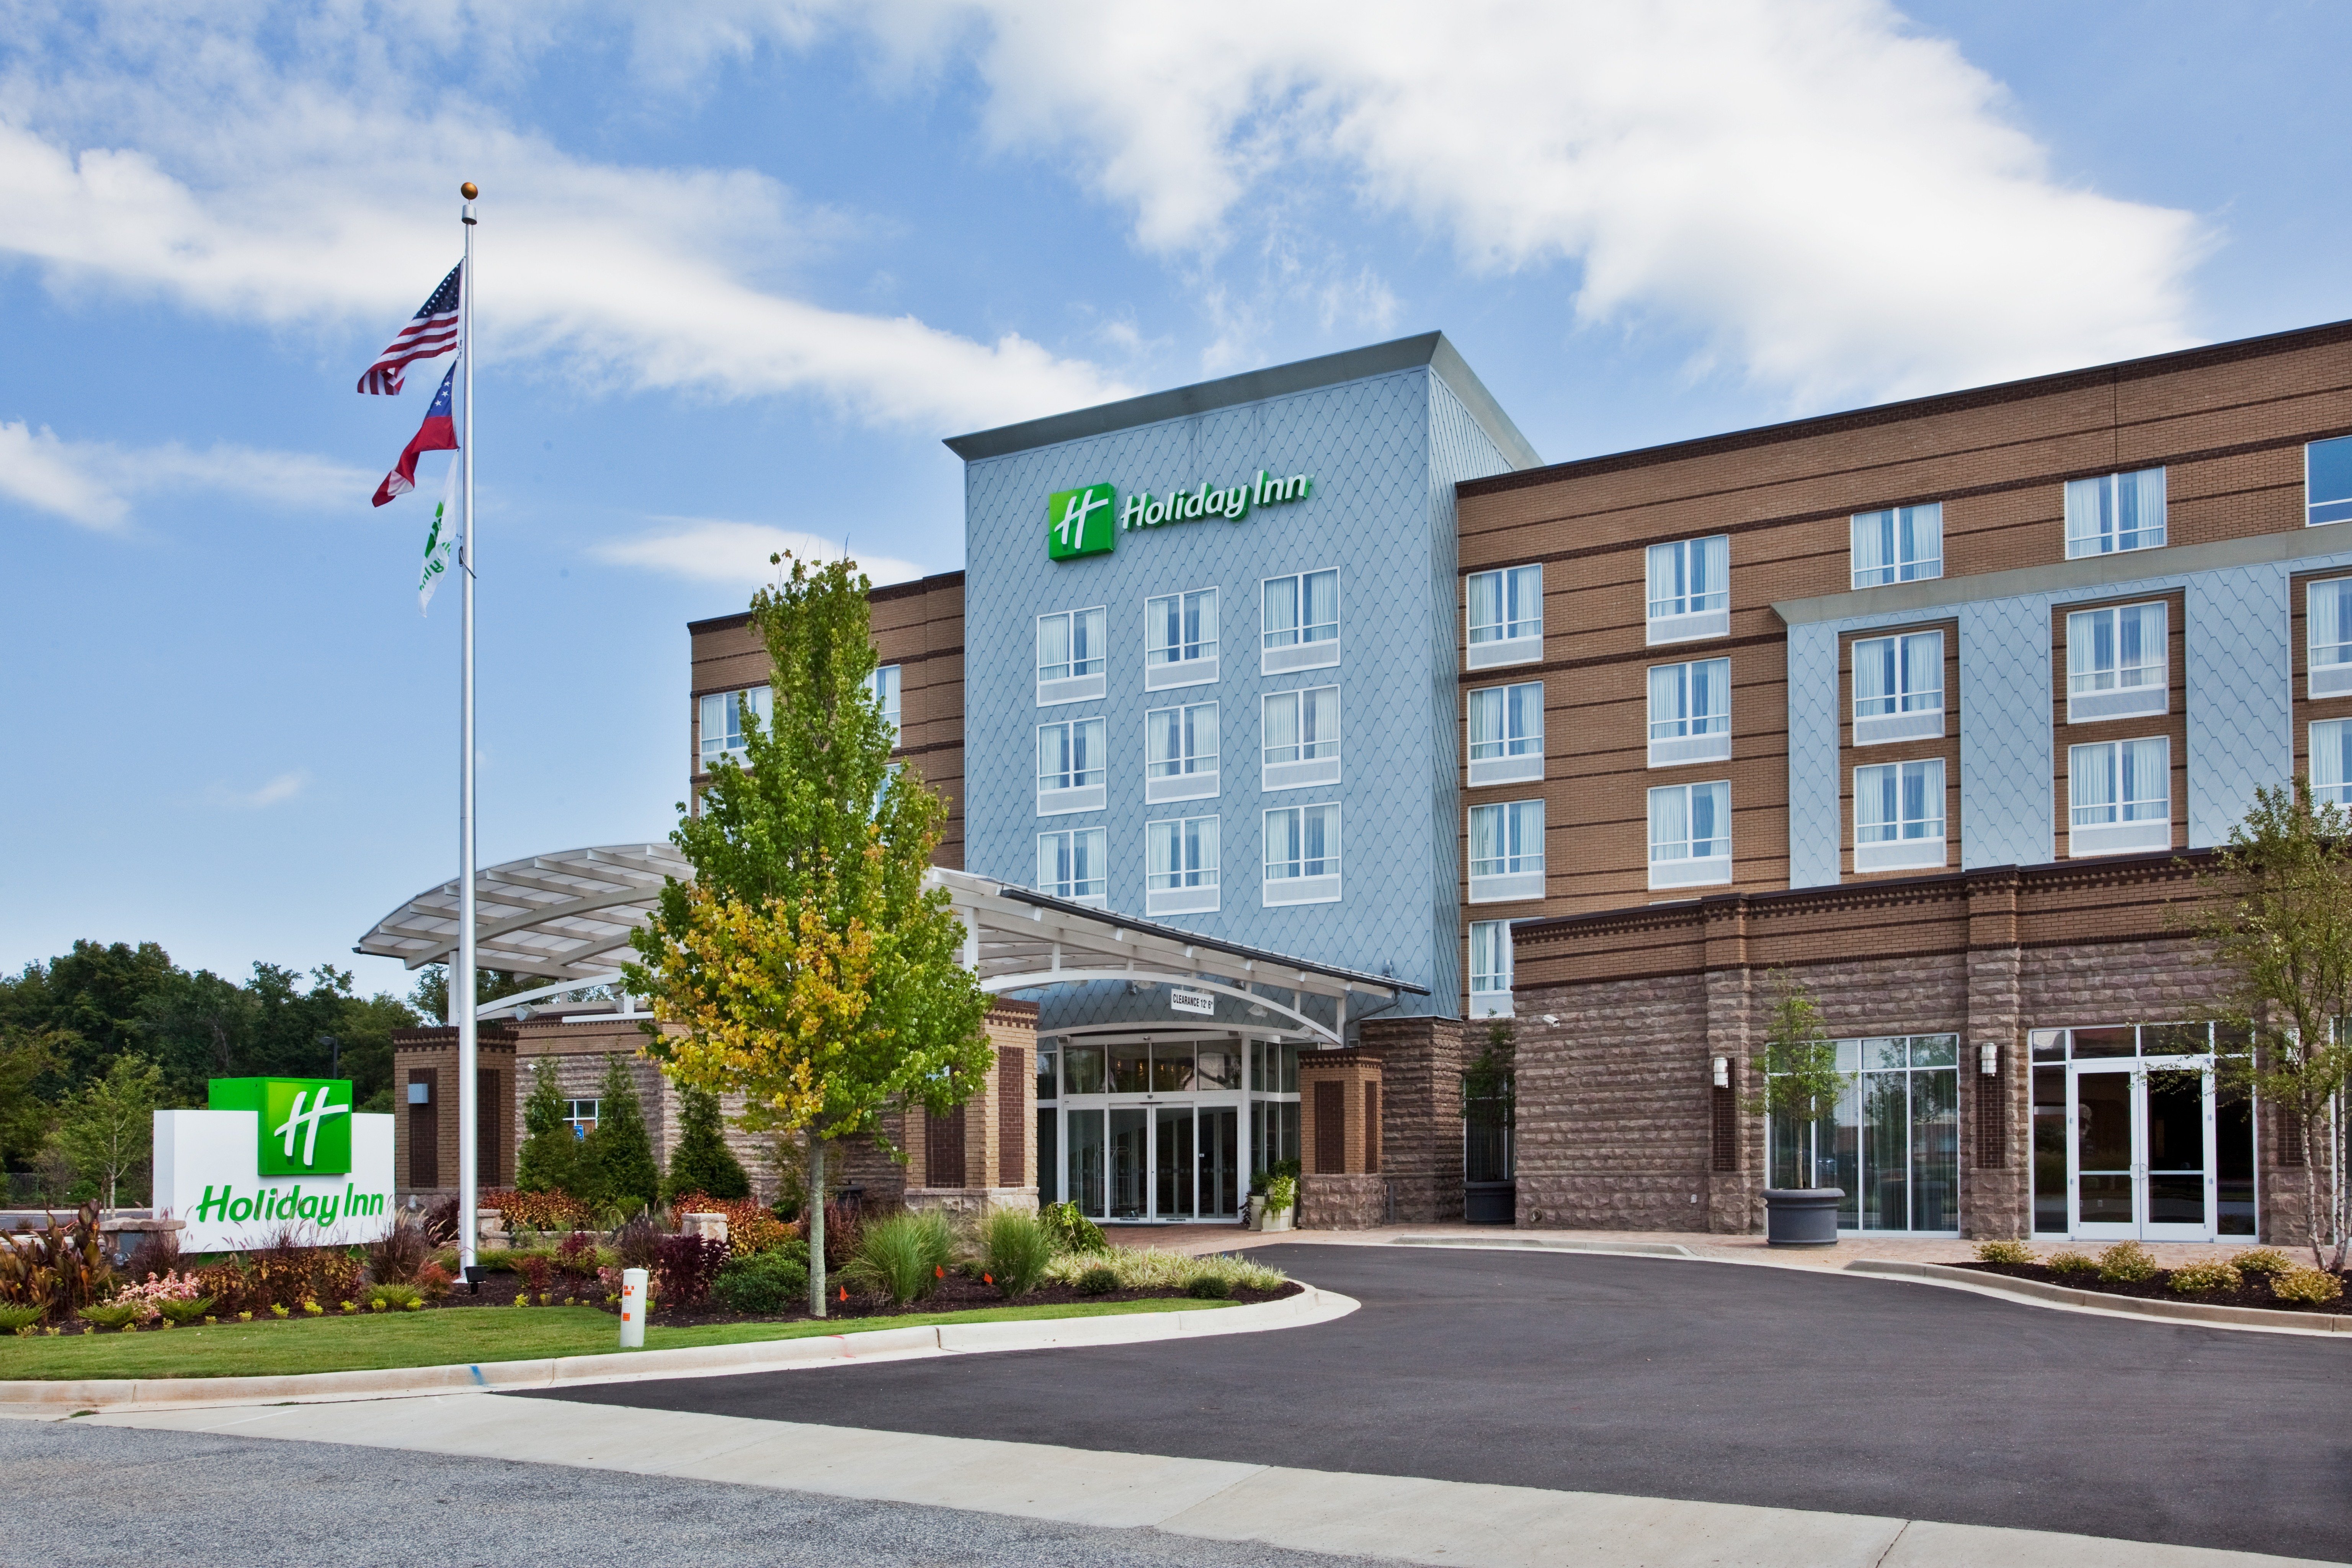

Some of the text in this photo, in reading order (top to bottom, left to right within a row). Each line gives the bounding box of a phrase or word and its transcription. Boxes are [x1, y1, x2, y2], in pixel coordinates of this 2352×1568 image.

[1120, 469, 1307, 530] Holiday Inn
[1173, 994, 1199, 1007] CLEARANCE
[196, 1183, 384, 1227] Holiday Inn
